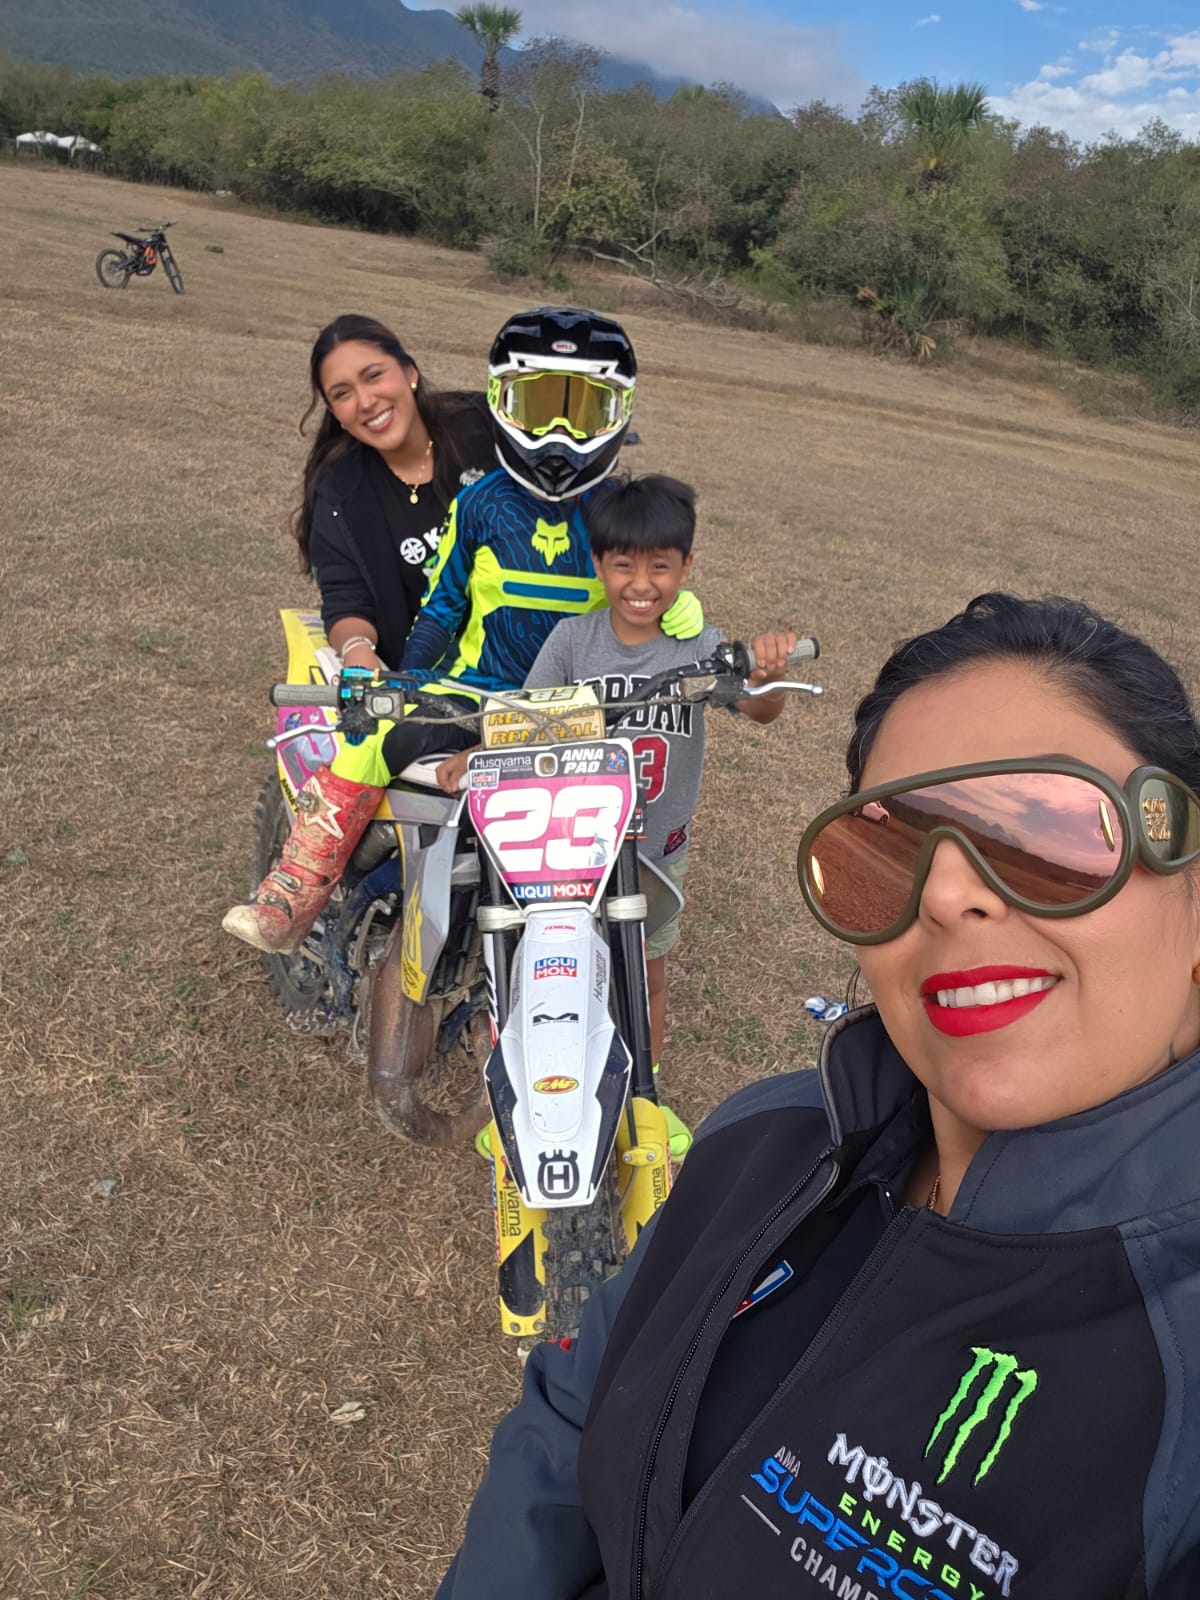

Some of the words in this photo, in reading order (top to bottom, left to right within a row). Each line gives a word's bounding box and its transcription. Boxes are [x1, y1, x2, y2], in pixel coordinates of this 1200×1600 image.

[423, 527, 444, 551] K
[474, 755, 532, 769] Husqvarna
[561, 748, 604, 761] ANNA
[563, 761, 601, 774] PAO
[482, 784, 624, 873] 23
[514, 884, 551, 899] LIQUI
[553, 883, 594, 897] MOLY
[537, 958, 575, 969] LIQUI
[535, 966, 575, 979] MOLY
[535, 1078, 577, 1092] FMF
[774, 1445, 801, 1478] AMA
[827, 1433, 1018, 1598] MONSTER
[838, 1492, 985, 1600] ENERGY
